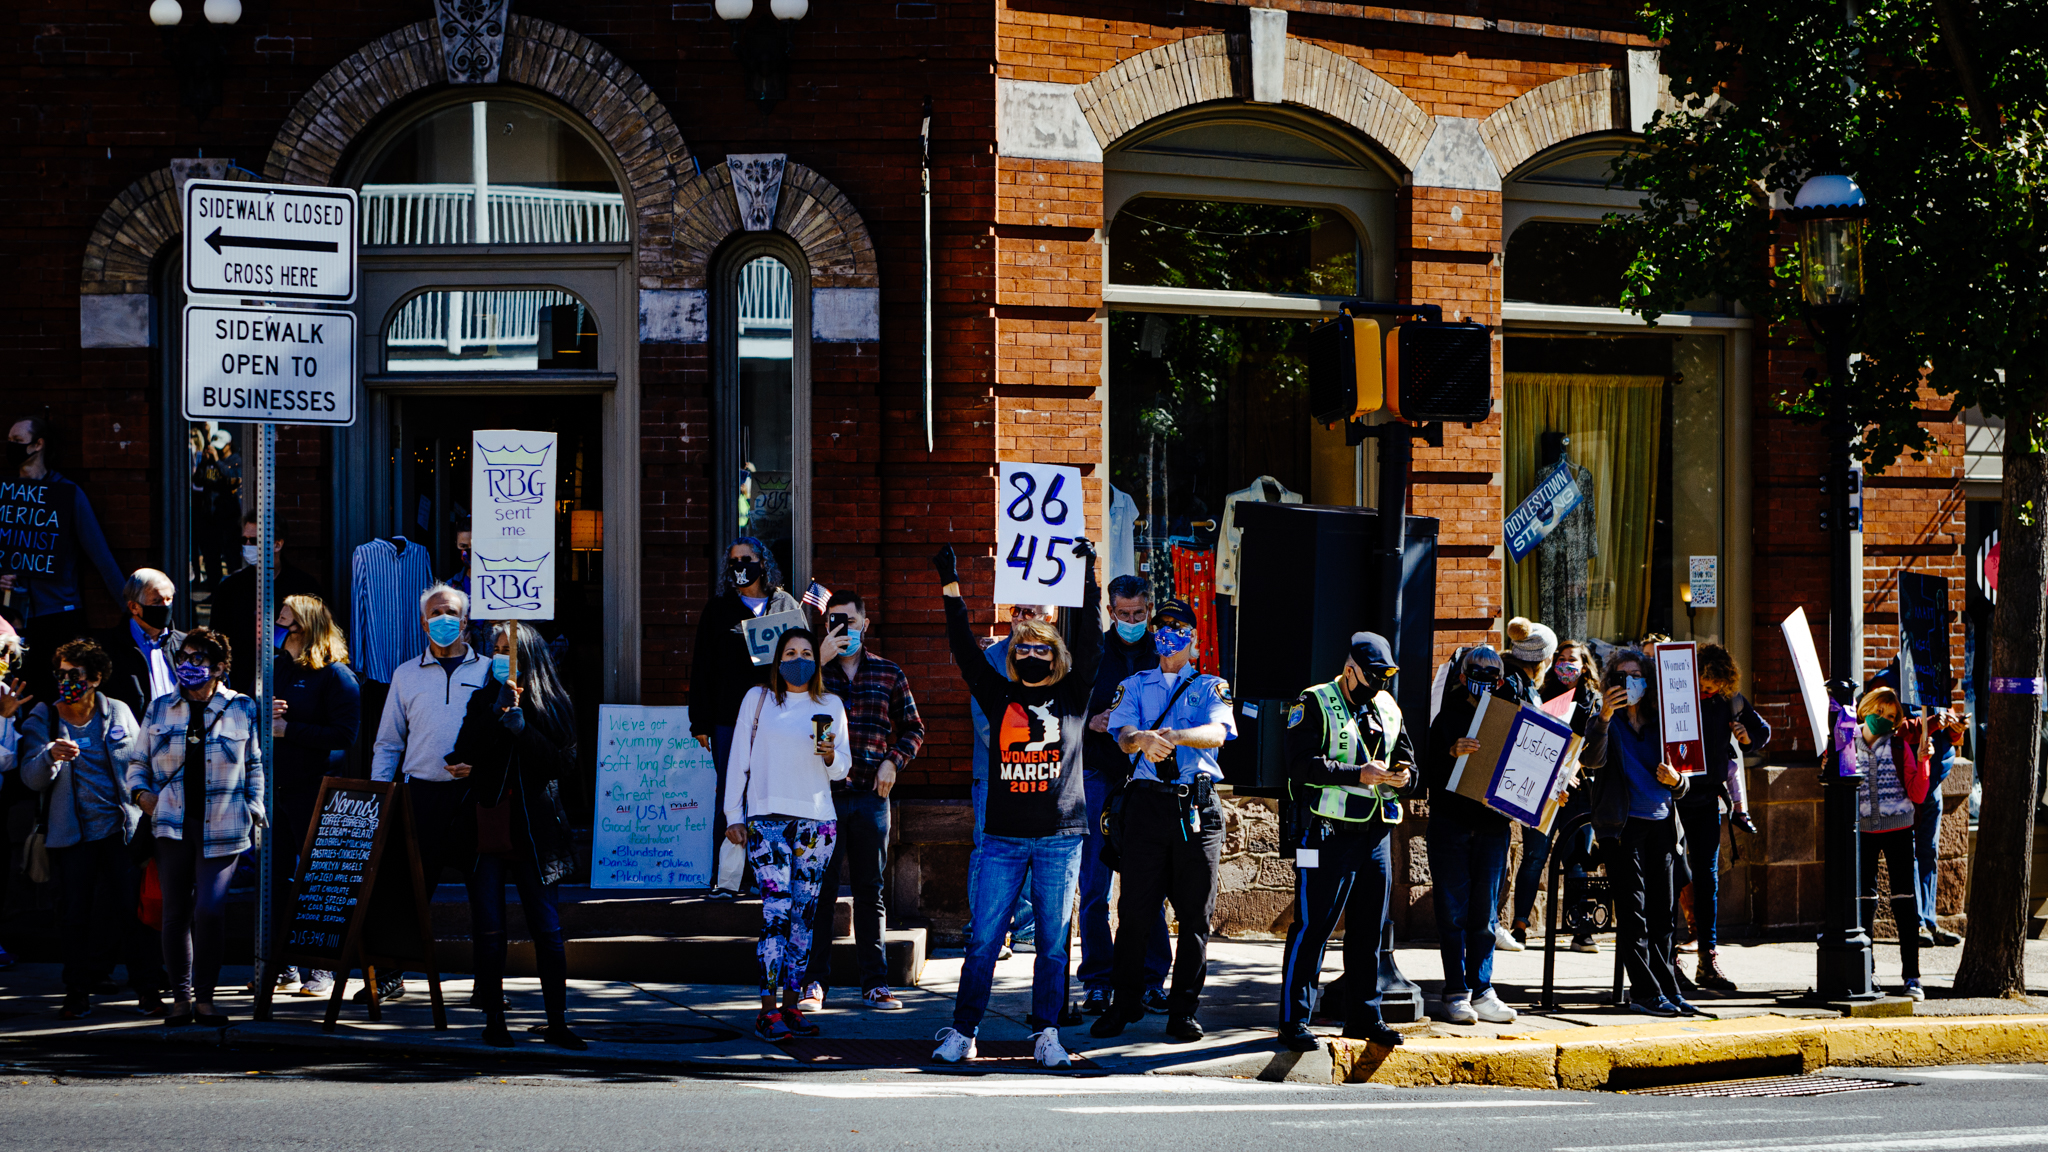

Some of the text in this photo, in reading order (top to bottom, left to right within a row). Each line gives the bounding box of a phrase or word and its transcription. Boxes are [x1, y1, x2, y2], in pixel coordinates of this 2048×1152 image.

[200, 197, 343, 226] SIDEWALK CLOSED
[224, 262, 318, 288] CROSS HERE
[216, 319, 324, 344] SIDEWALK
[222, 353, 317, 377] OPEN TO
[203, 386, 336, 412] BUSINESSES
[0, 482, 48, 504] MAKE
[483, 469, 546, 504] RBG
[1006, 471, 1068, 526] 86
[1505, 470, 1568, 538] DOYLESTOWN
[0, 505, 59, 528] ERICA
[495, 506, 535, 521] sent
[0, 528, 59, 550] MINIST
[502, 526, 526, 536] me
[11, 552, 55, 574] ONCE
[1006, 532, 1074, 587] 45
[477, 574, 543, 611] RBG
[1664, 659, 1690, 671] Women's
[1467, 680, 1492, 697] VOTE
[1669, 678, 1687, 692] Rights
[1670, 702, 1690, 715] Benefit
[610, 715, 667, 735] We've got
[1329, 696, 1348, 750] POLICE
[1675, 720, 1688, 732] ALL
[616, 737, 663, 755] yummy
[1515, 720, 1559, 763] Justice
[1001, 749, 1060, 763] WOMEN'S
[637, 754, 658, 778] long
[1000, 761, 1061, 780] MARCH
[639, 773, 667, 788] And
[1010, 780, 1048, 793] 2018
[1499, 768, 1535, 797] For All
[324, 790, 380, 819] Nonno's
[612, 785, 689, 807] Great jeans
[636, 804, 667, 820] USA
[670, 799, 698, 809] made
[321, 817, 342, 826] COFFEE
[602, 815, 707, 837] Good for your feet
[317, 826, 374, 840] ICE CREAM GELATO
[310, 848, 337, 859] PASTRIES
[616, 845, 674, 857] Blundstone
[310, 860, 363, 871] BROOKLYN BAGELS
[602, 857, 693, 868] Dansko Olukai
[303, 872, 315, 883] HOT
[318, 872, 334, 882] ICED
[349, 875, 364, 883] CIDE
[308, 884, 322, 893] HOT
[324, 895, 347, 905] SPICED
[324, 904, 344, 912] BREW
[296, 912, 321, 921] INDOOR
